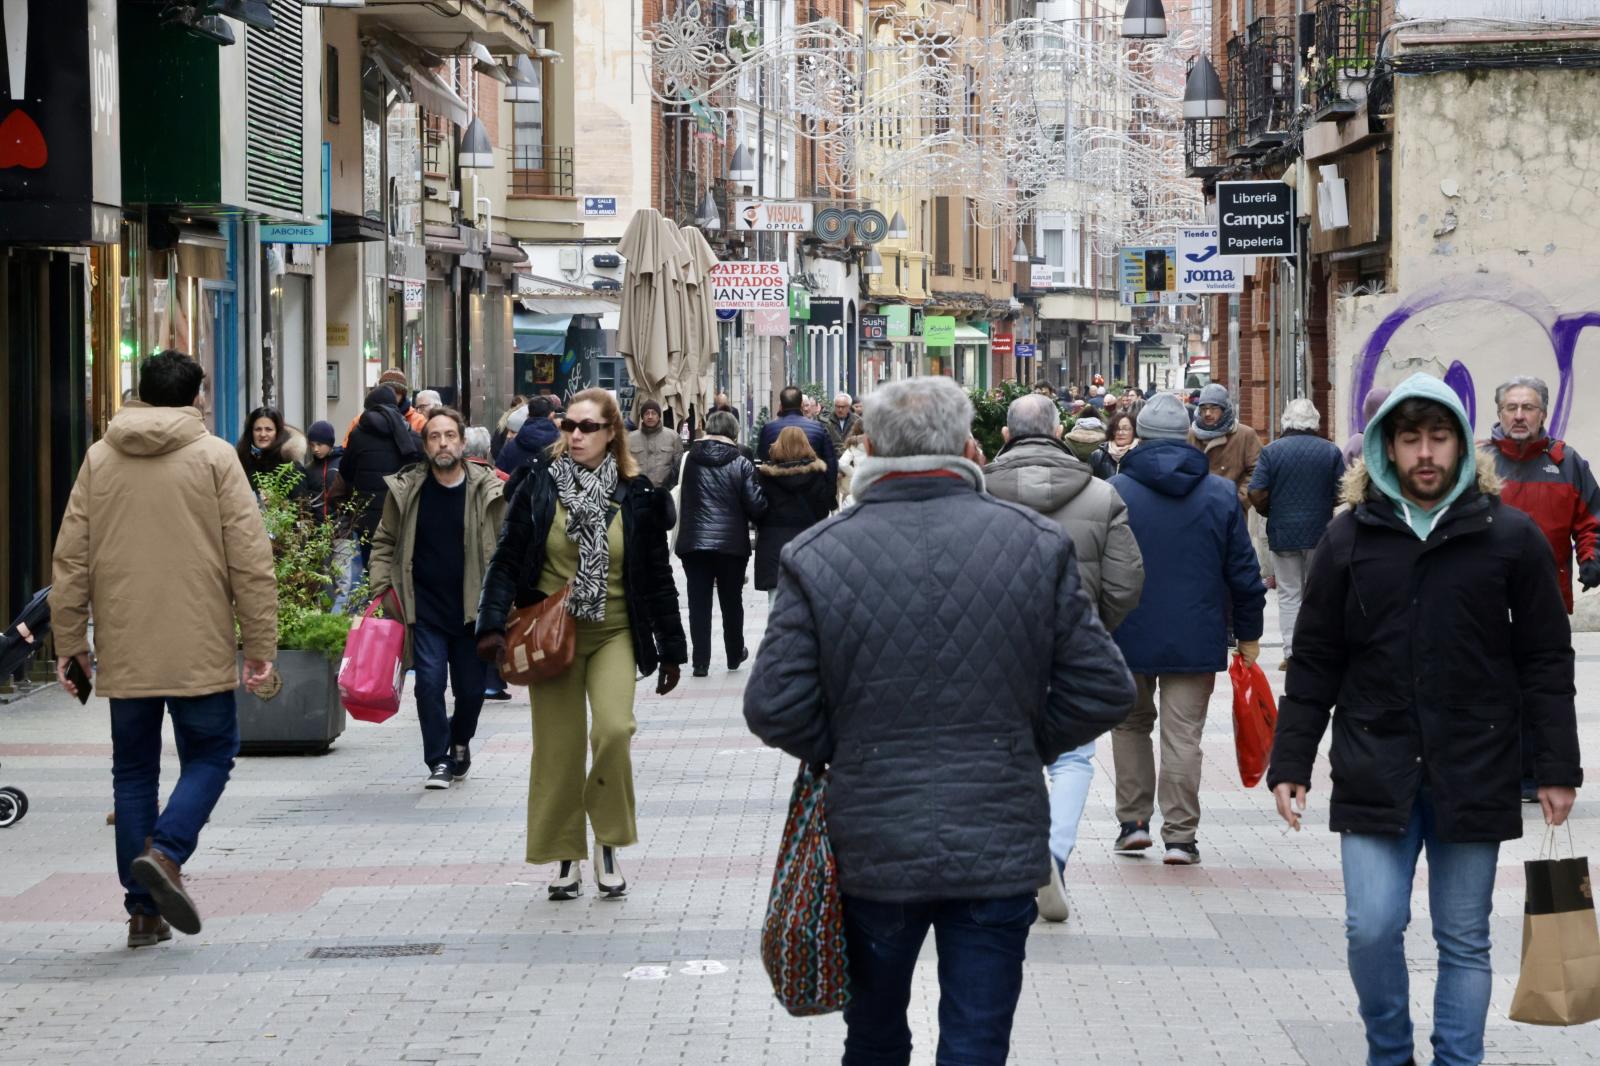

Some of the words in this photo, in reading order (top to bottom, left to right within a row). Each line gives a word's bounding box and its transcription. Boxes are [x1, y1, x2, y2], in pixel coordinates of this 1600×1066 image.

[1232, 192, 1277, 204] Librería
[766, 205, 804, 222] VISUAL
[1223, 212, 1285, 229] Campus
[271, 228, 314, 236] JABONES
[1228, 236, 1283, 249] Papelería
[711, 263, 780, 275] PAPELES
[862, 317, 886, 326] Sushi
